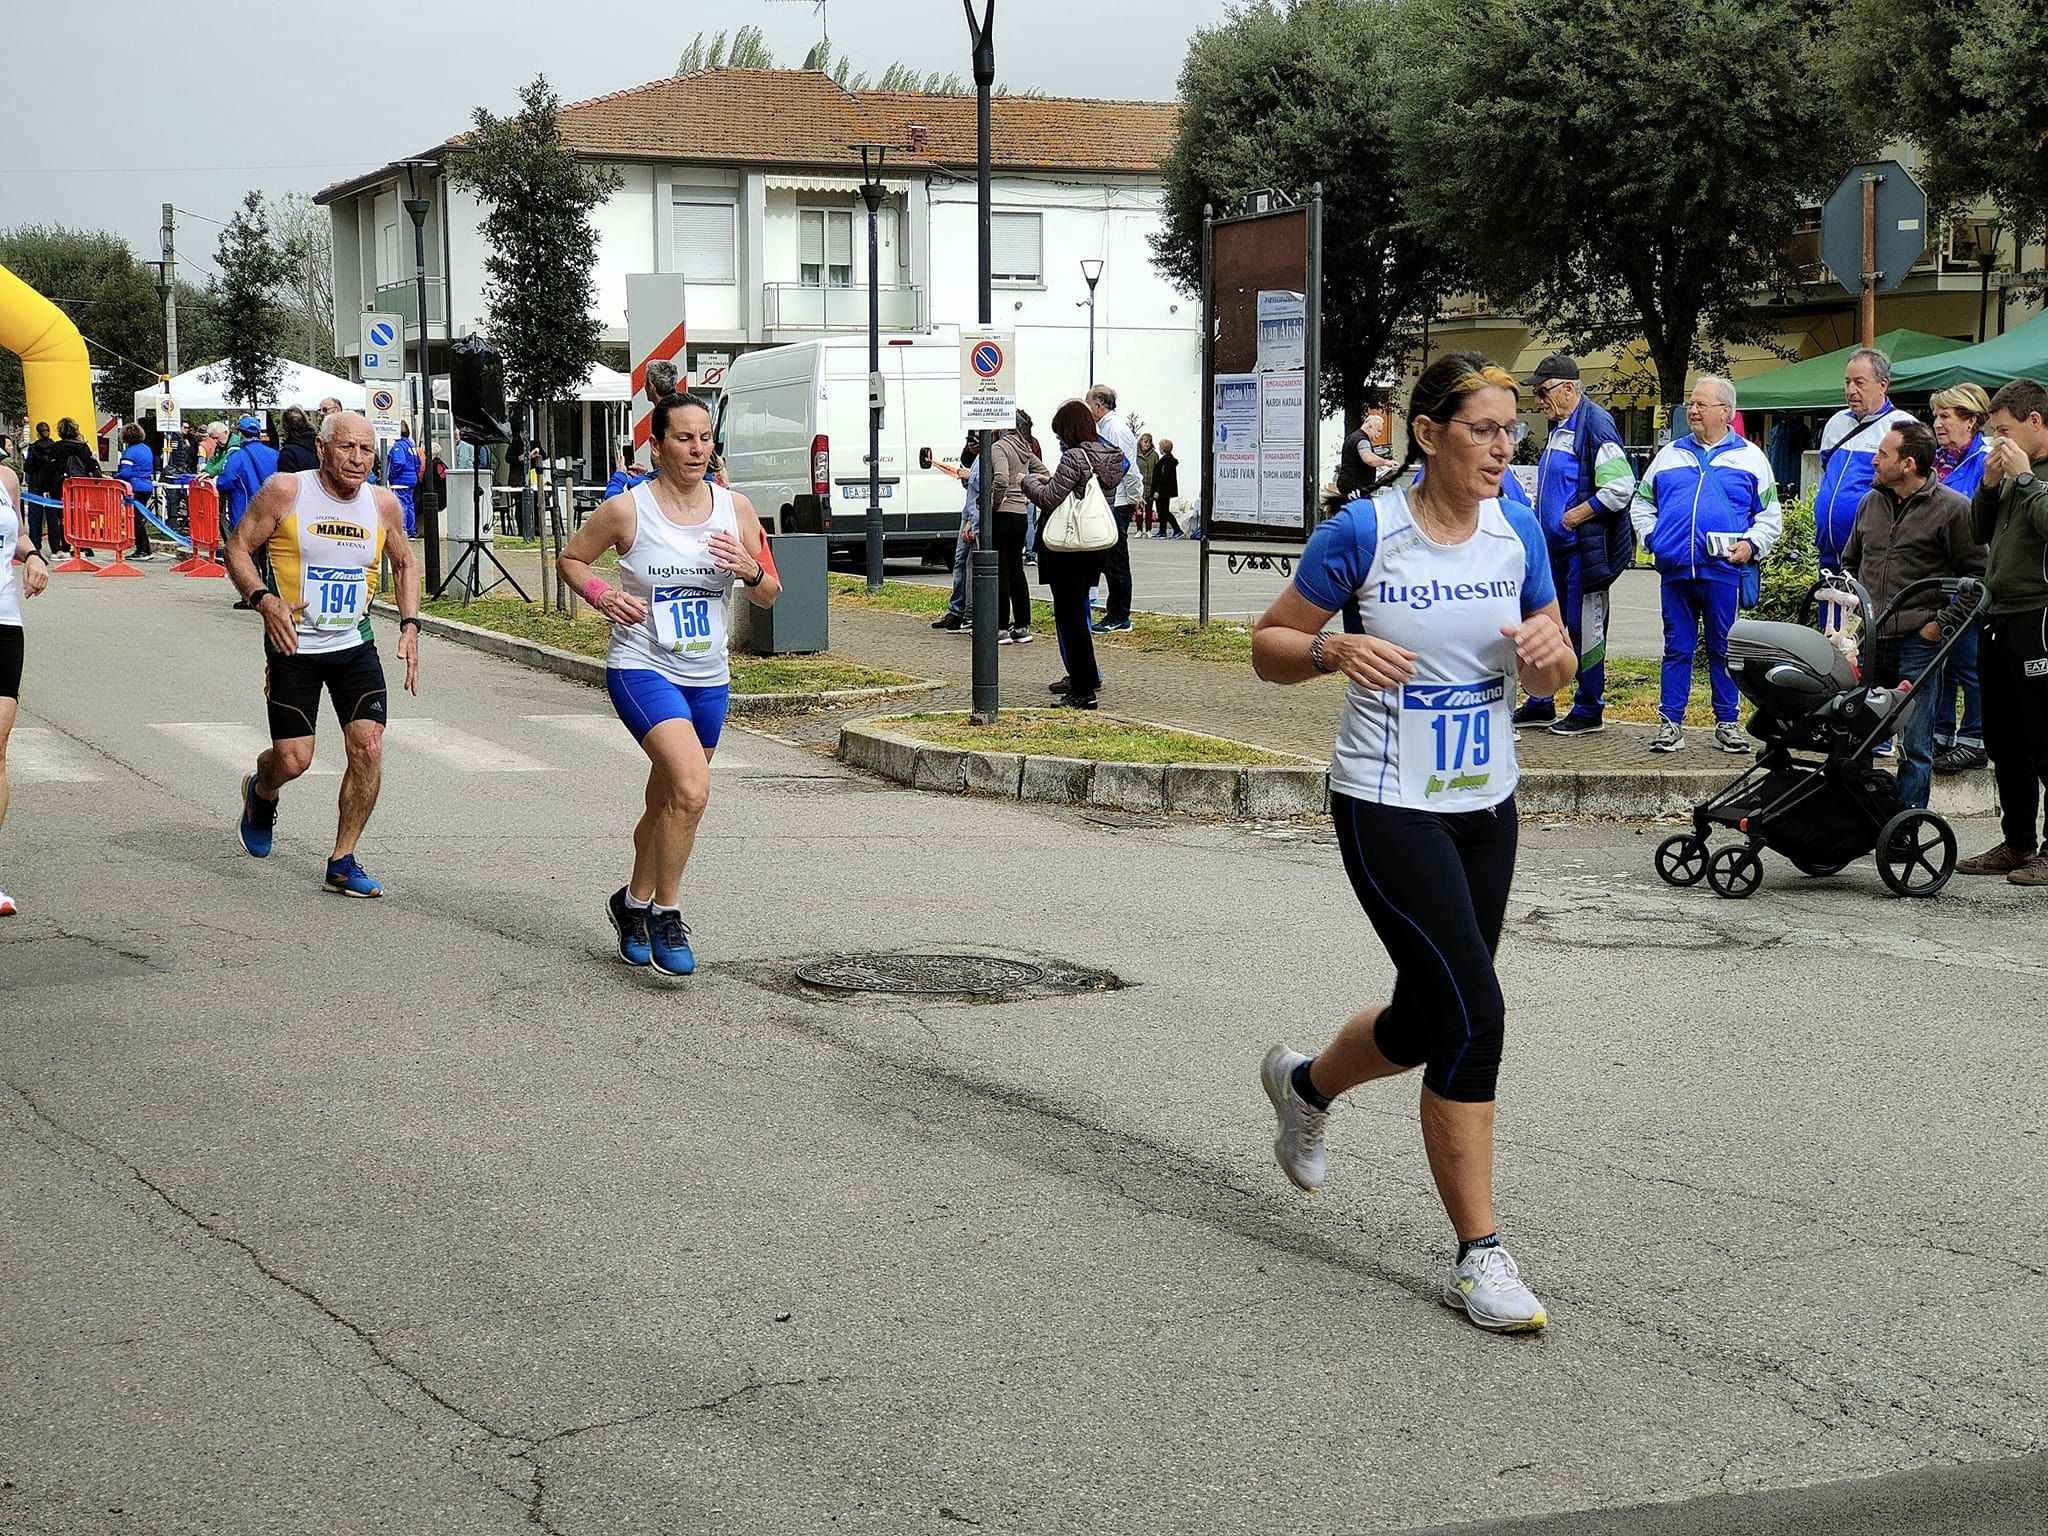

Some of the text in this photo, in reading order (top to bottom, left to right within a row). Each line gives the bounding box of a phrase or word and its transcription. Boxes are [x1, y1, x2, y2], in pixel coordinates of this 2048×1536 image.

[1260, 319, 1303, 341] Ivan Alvisi
[367, 355, 376, 366] P
[1265, 380, 1302, 388] RINGRAZIAMENTO
[1223, 384, 1256, 401] Anselmo Alvisi
[1265, 397, 1303, 408] NARDI NATALIA
[1219, 453, 1255, 461] RINGRAZIAMENTO
[1264, 452, 1300, 460] RINGRAZIAMENTO
[1218, 467, 1256, 480] ALVISI IVAN
[1279, 470, 1302, 479] ANSELMO
[316, 524, 364, 539] MAMELI
[336, 541, 367, 550] RAVENNA
[648, 565, 716, 578] lughesina
[319, 583, 357, 614] 194
[1379, 579, 1517, 610] lughesina
[669, 599, 711, 639] 158
[2025, 660, 2047, 673] EA7
[1431, 709, 1490, 771] 179
